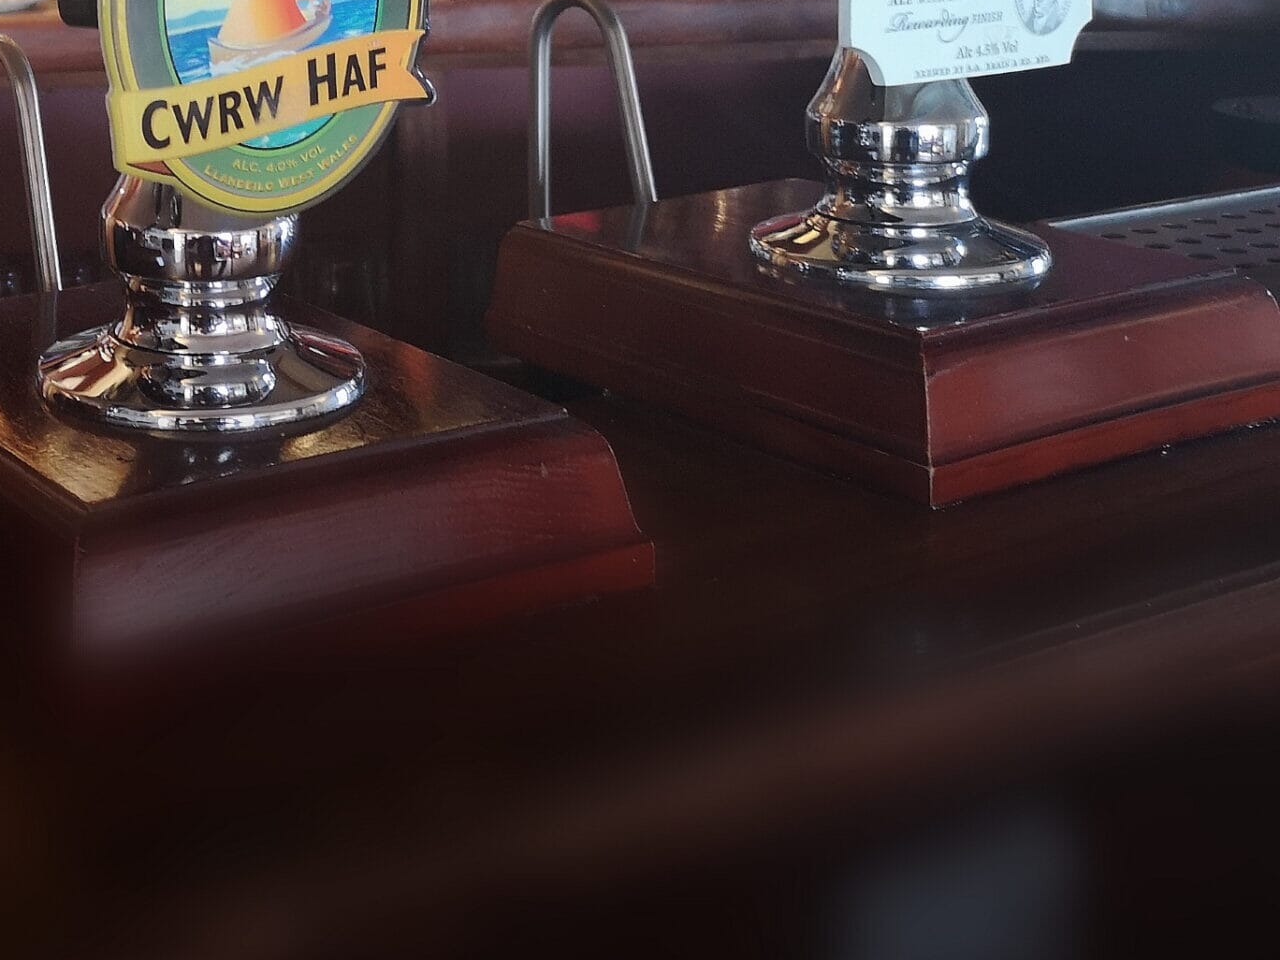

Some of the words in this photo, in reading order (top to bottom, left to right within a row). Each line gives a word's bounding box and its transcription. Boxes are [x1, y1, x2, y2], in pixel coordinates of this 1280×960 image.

[971, 10, 1004, 25] FINISH
[140, 75, 285, 150] CWRW
[306, 47, 387, 107] HAF
[231, 158, 262, 173] ALC.
[265, 160, 300, 174] 4.0%
[300, 144, 327, 163] VOL
[278, 166, 315, 189] WEST
[316, 133, 358, 171] WALES
